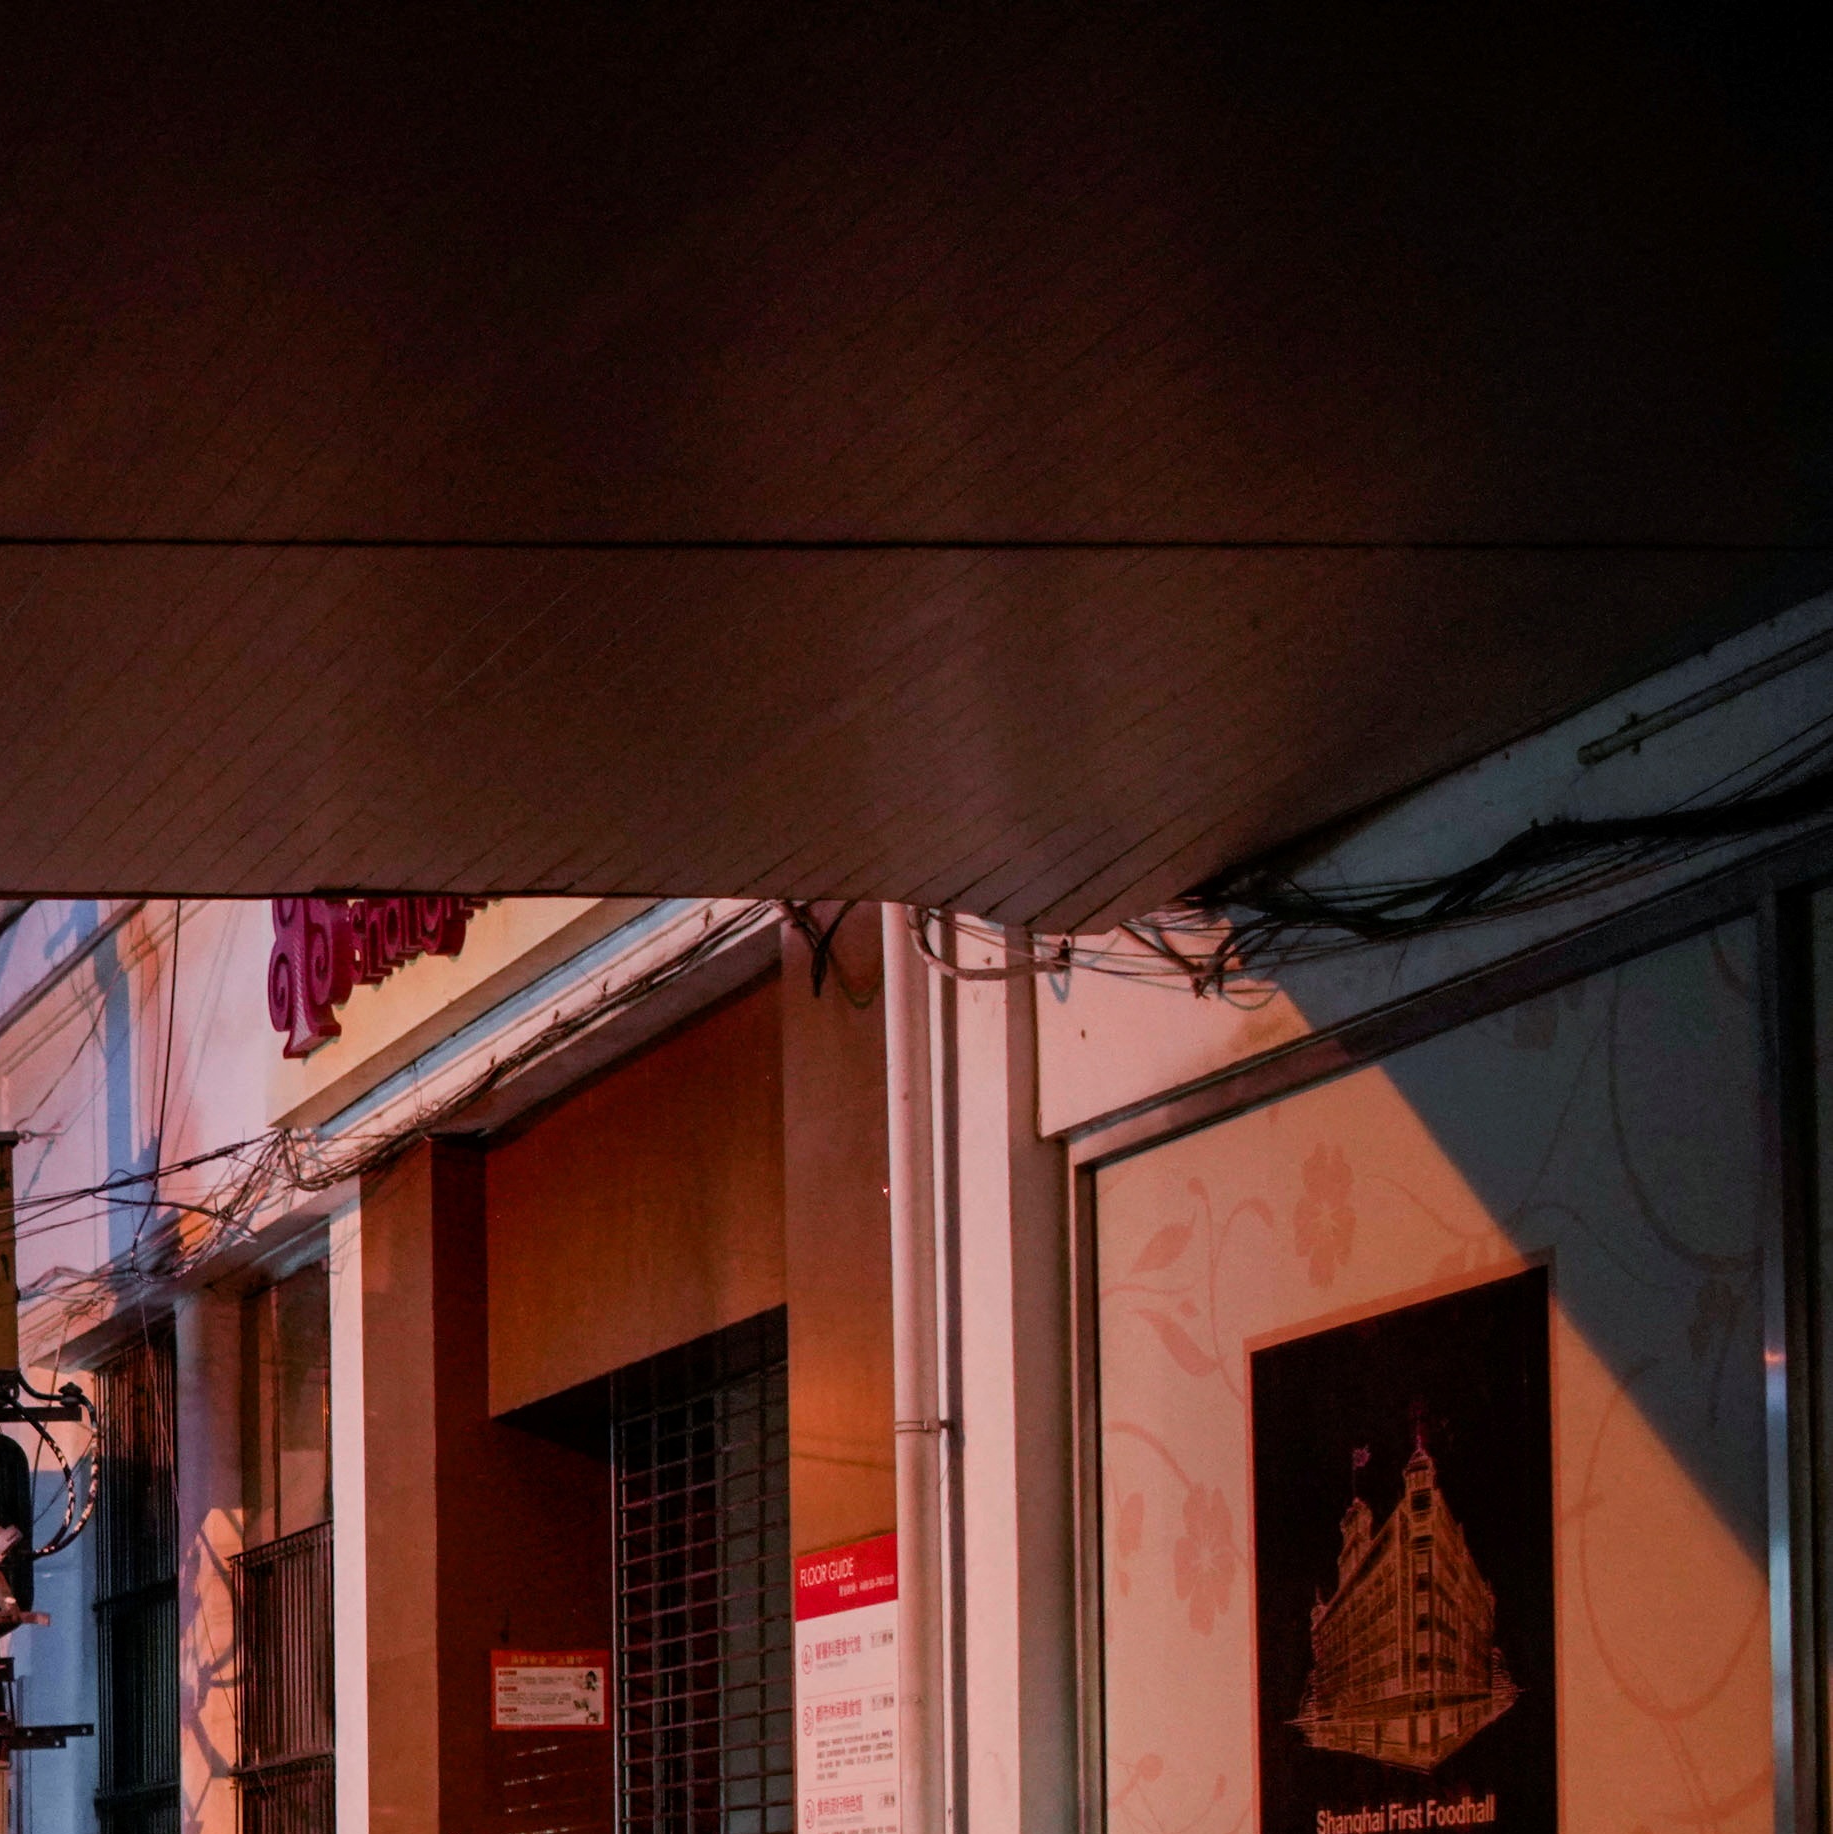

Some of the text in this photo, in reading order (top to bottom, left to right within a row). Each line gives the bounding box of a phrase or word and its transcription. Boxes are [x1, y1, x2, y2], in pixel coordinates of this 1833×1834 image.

[800, 1557, 854, 1588] FLOOR GUIDE
[1388, 1803, 1423, 1831] First
[1426, 1794, 1496, 1828] Foodhall
